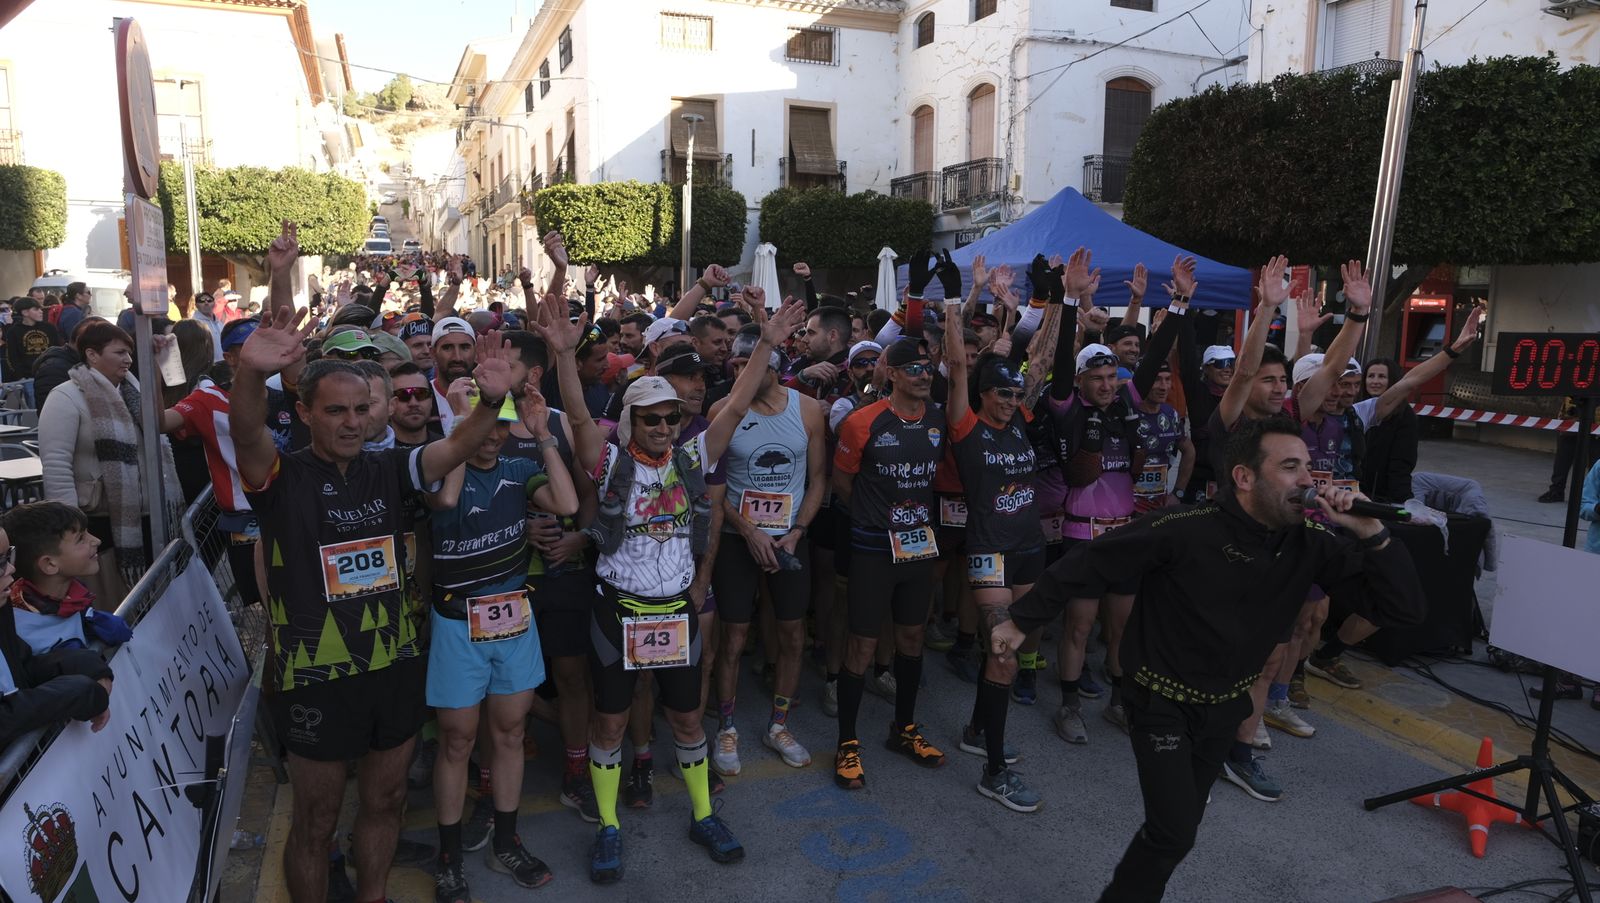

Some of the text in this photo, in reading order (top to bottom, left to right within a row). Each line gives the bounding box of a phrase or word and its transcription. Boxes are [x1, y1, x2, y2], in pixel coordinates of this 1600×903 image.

[751, 500, 783, 514] 117
[457, 530, 503, 552] SIEMPRE
[900, 530, 928, 545] 256
[337, 551, 385, 576] 208
[488, 603, 513, 621] 31
[643, 631, 671, 647] 43
[92, 601, 213, 828] AYUNTAMIENTO DE
[107, 634, 237, 903] CANTORIA
